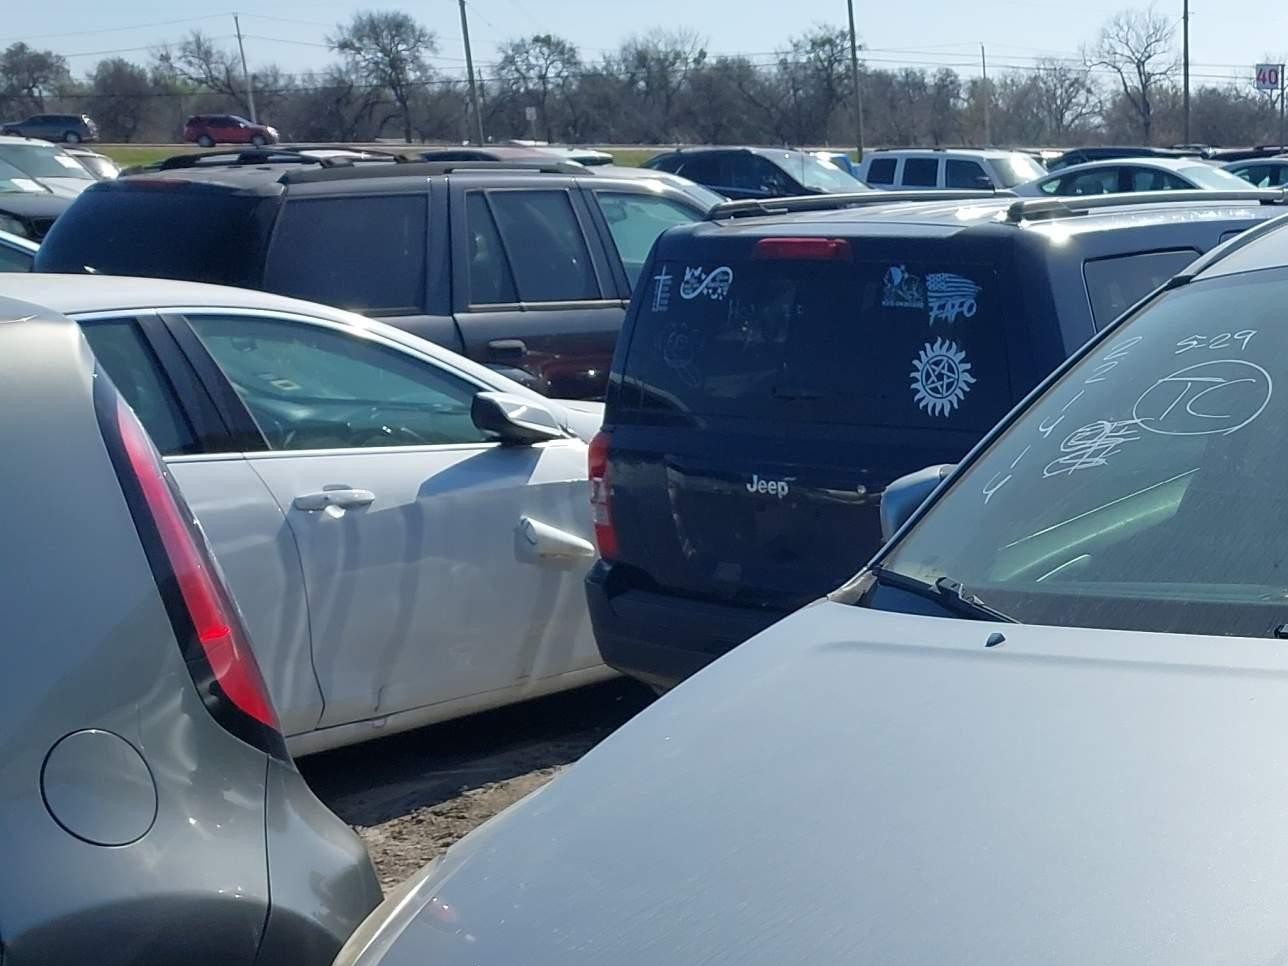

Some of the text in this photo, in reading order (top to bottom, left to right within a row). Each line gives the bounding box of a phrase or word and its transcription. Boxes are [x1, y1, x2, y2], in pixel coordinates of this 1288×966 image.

[1256, 68, 1278, 85] 40
[1157, 377, 1257, 421] TC
[746, 474, 789, 499] Jeep
